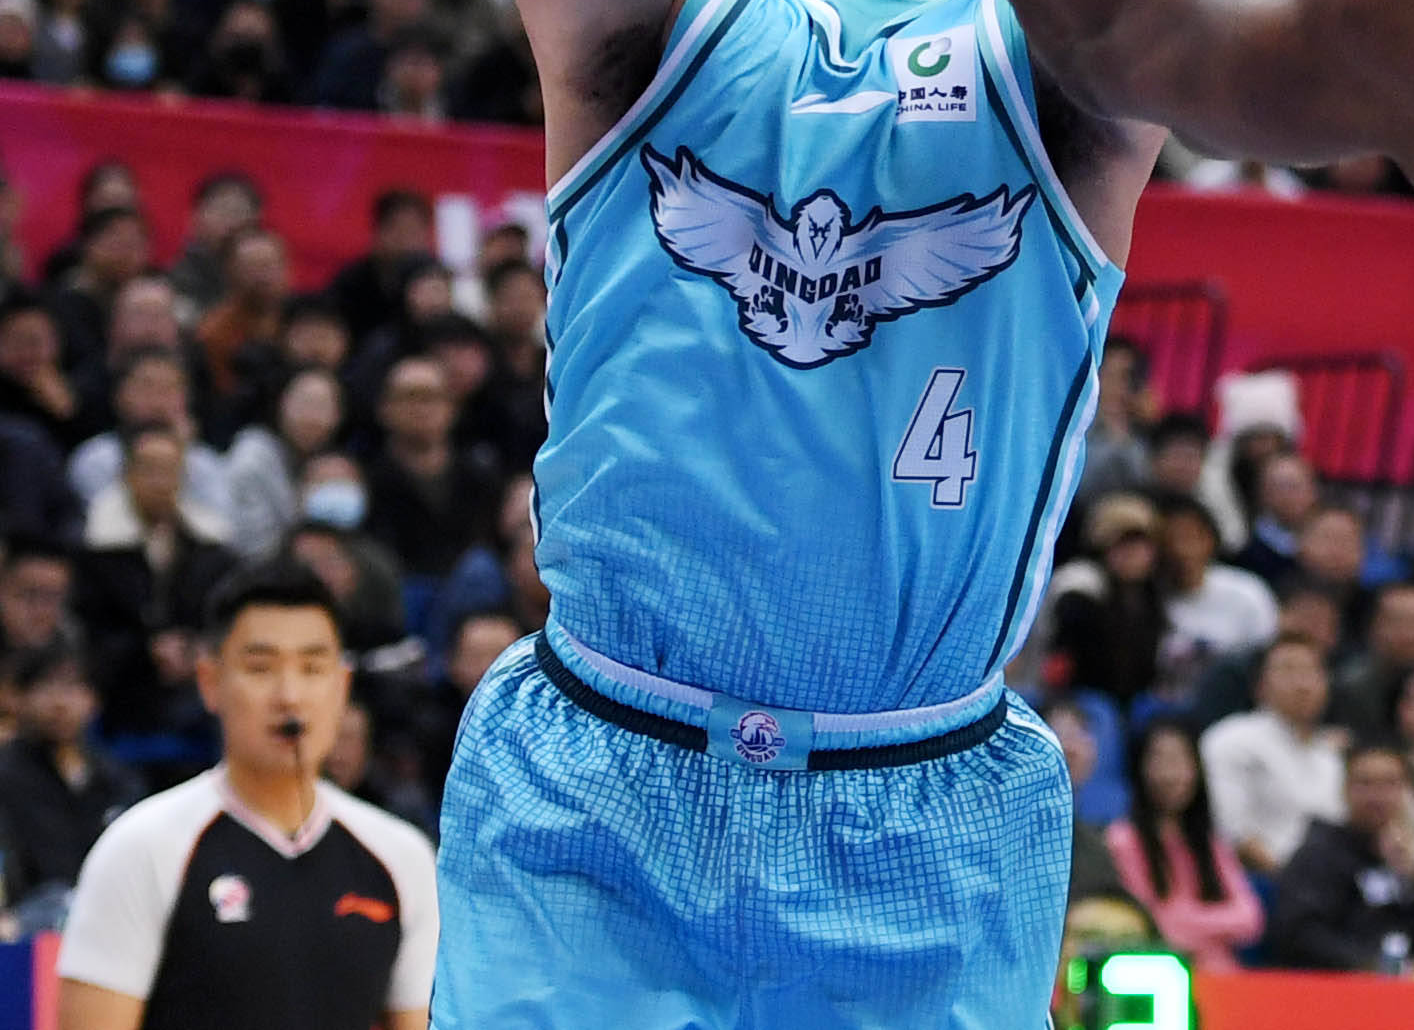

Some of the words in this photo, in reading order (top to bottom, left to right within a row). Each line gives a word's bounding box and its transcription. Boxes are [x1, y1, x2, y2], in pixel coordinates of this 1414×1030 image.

[938, 102, 967, 112] LIFE
[749, 241, 882, 305] QINGDAO
[893, 368, 978, 507] 4
